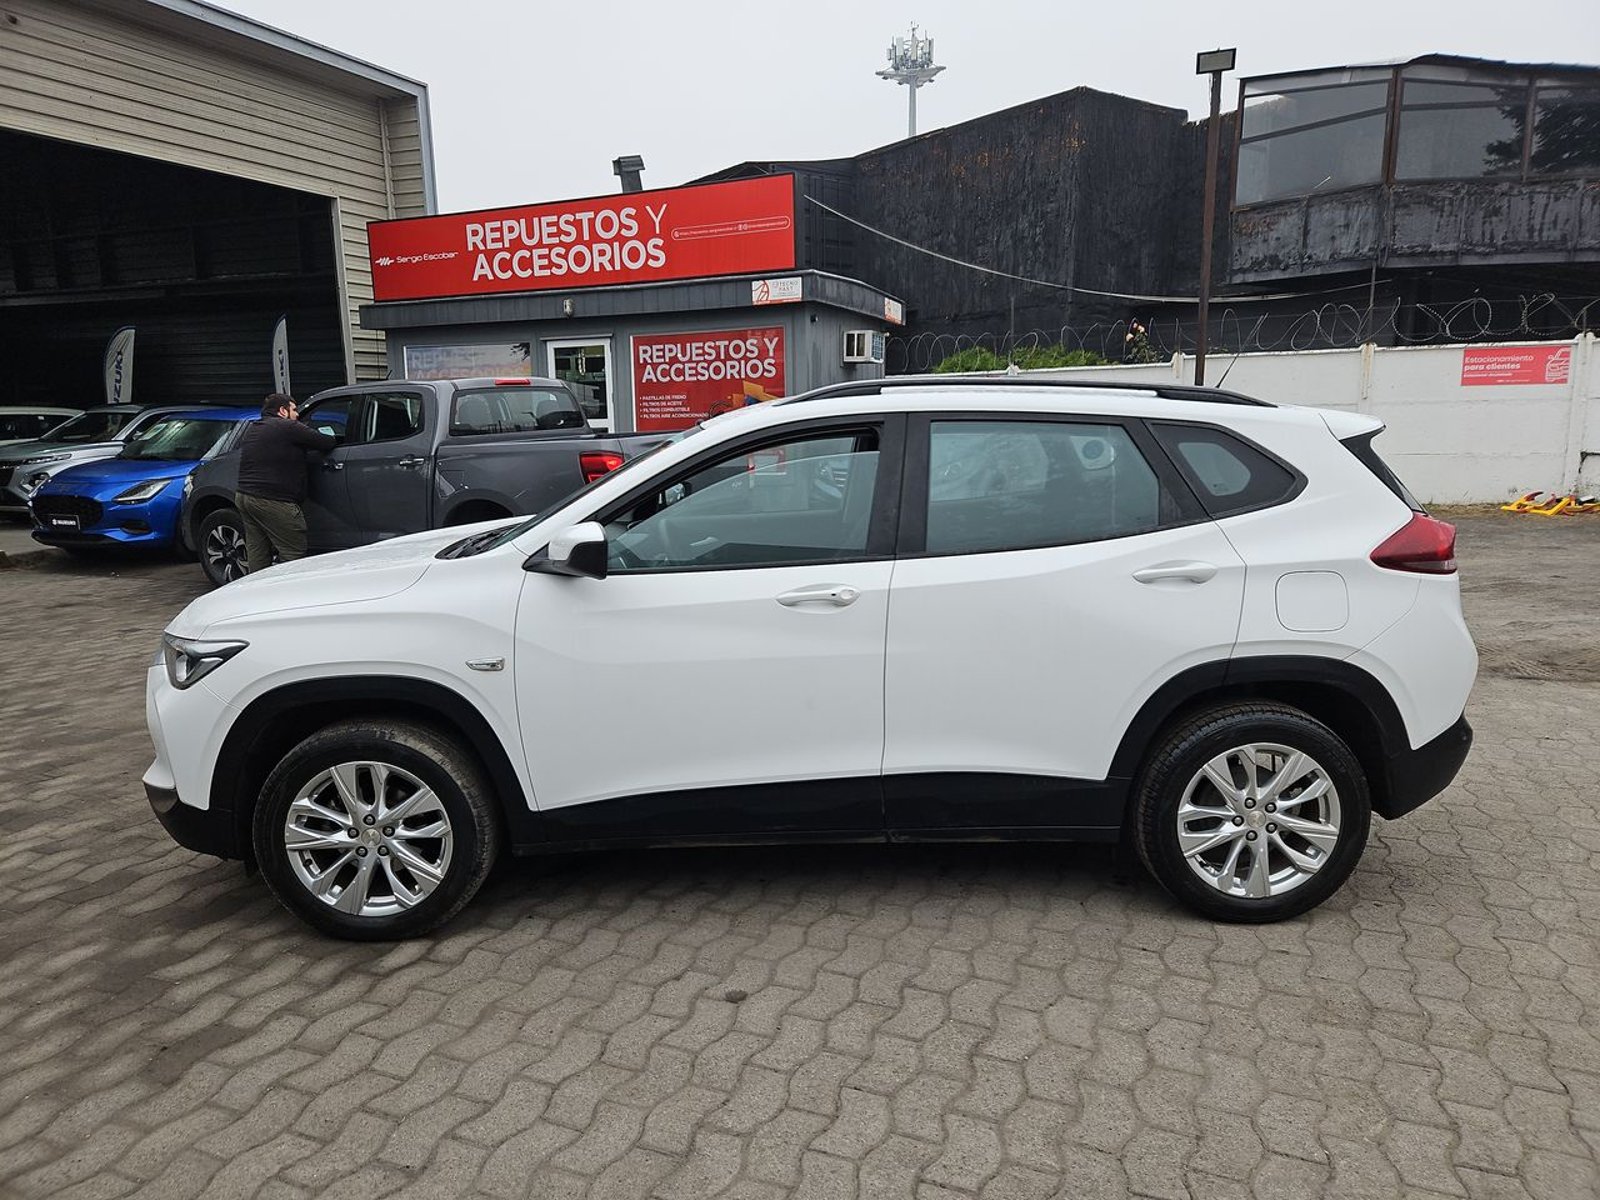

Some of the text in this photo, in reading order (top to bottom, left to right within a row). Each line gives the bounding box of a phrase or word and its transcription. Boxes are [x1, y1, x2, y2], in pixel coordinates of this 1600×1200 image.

[465, 203, 667, 251] REPUESTOS Y
[423, 252, 459, 261] Escobar
[472, 238, 666, 281] ACCESORIOS
[639, 337, 779, 364] REPUESTOS Y
[1464, 354, 1535, 363] Estacionamiento
[642, 358, 777, 383] ACCESORIOS
[1486, 362, 1521, 371] clientes
